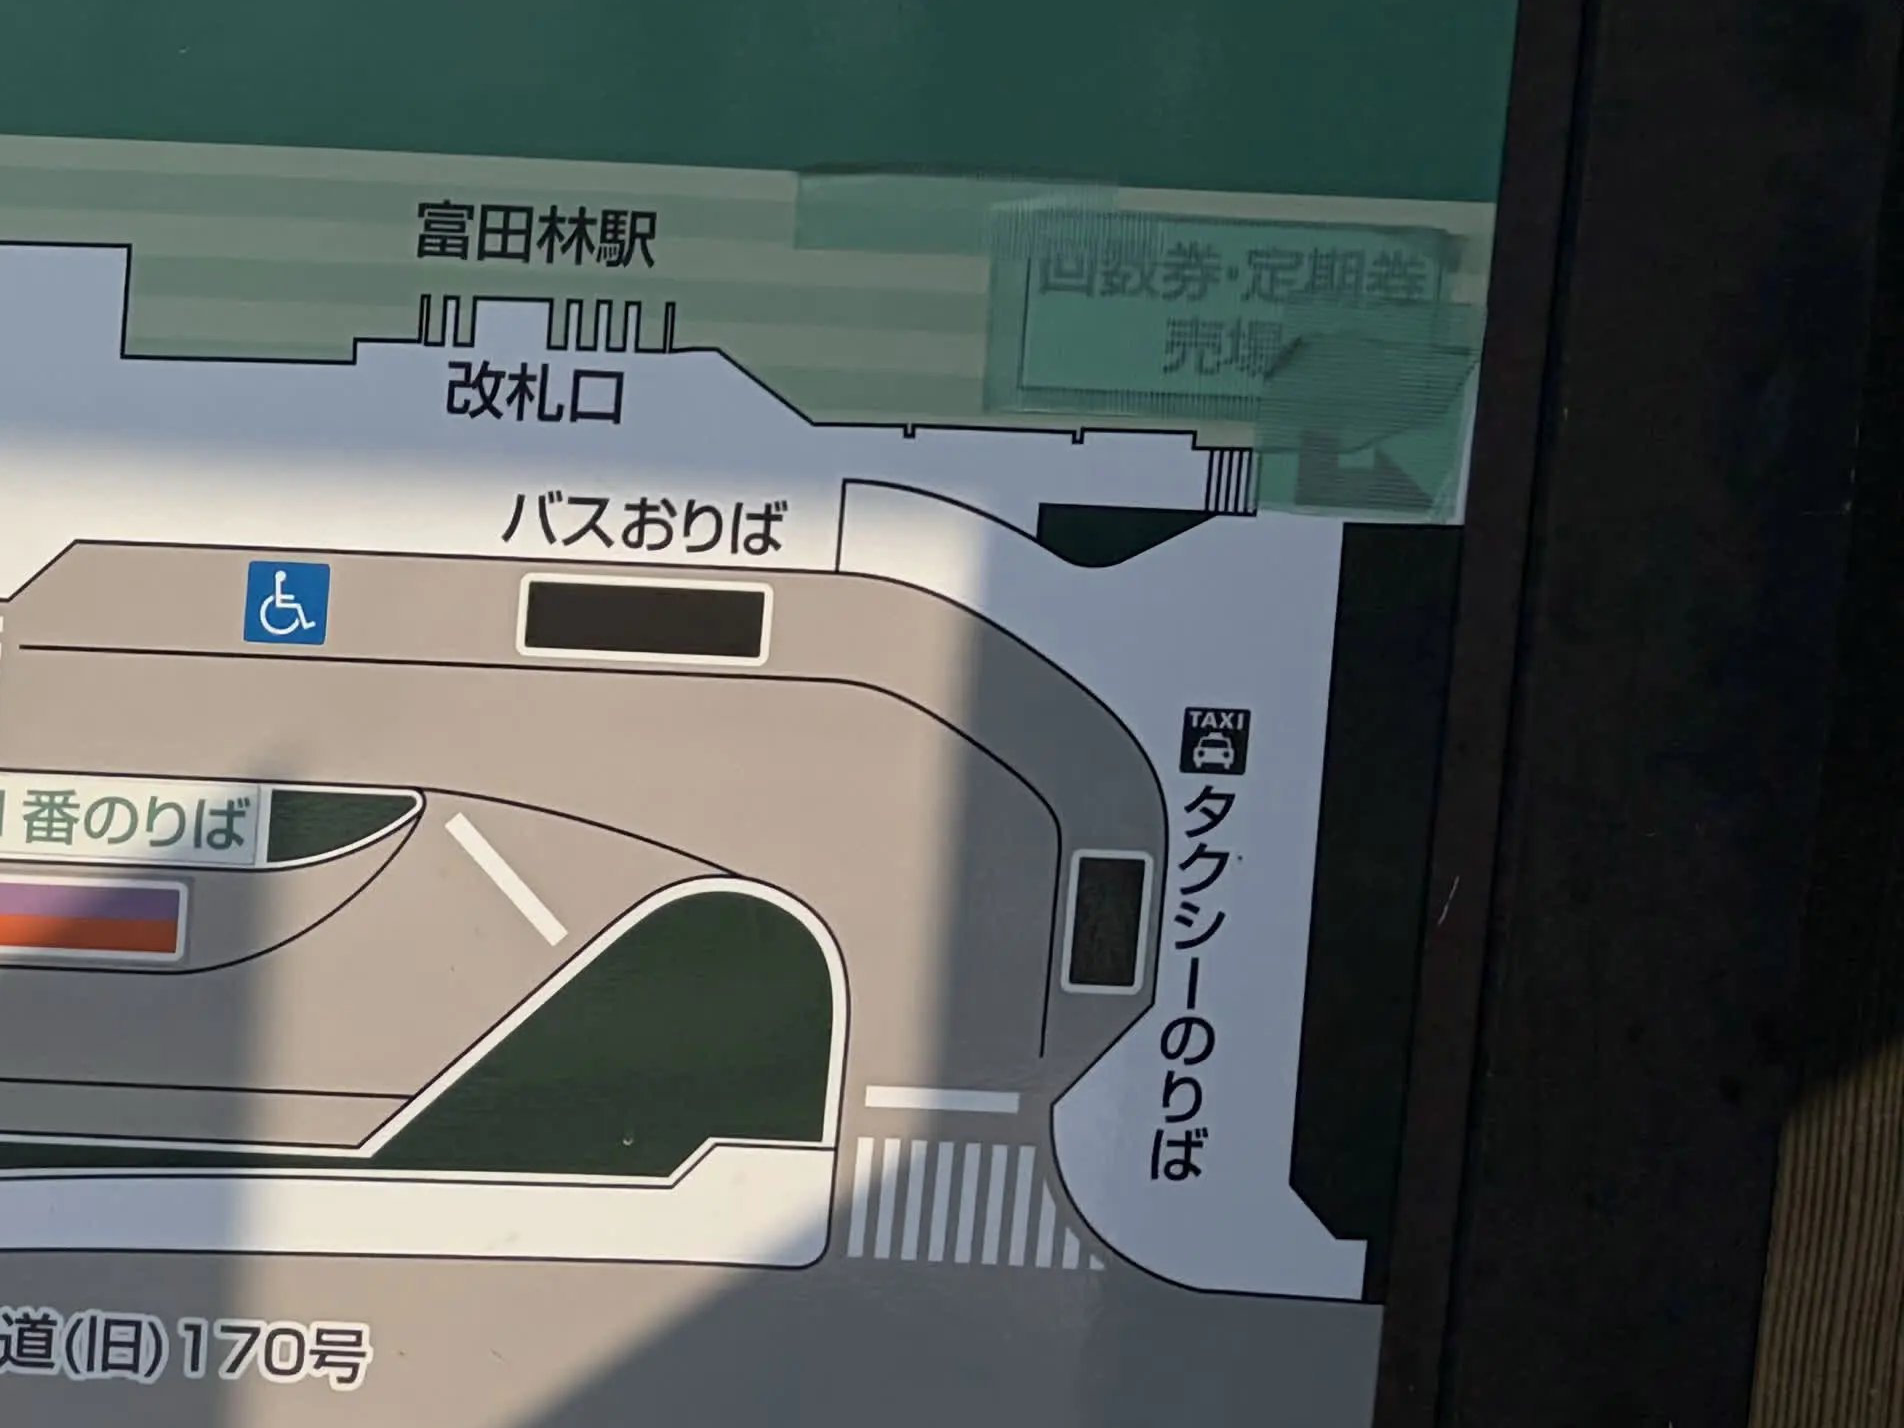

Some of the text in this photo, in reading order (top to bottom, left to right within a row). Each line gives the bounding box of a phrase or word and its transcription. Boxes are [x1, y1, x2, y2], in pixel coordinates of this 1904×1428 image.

[412, 199, 660, 270] 富田林駅
[442, 358, 629, 428] 改札口
[501, 490, 791, 561] バスおりば
[1186, 710, 1248, 732] TAXI
[1149, 784, 1236, 1183] タクシーのりば
